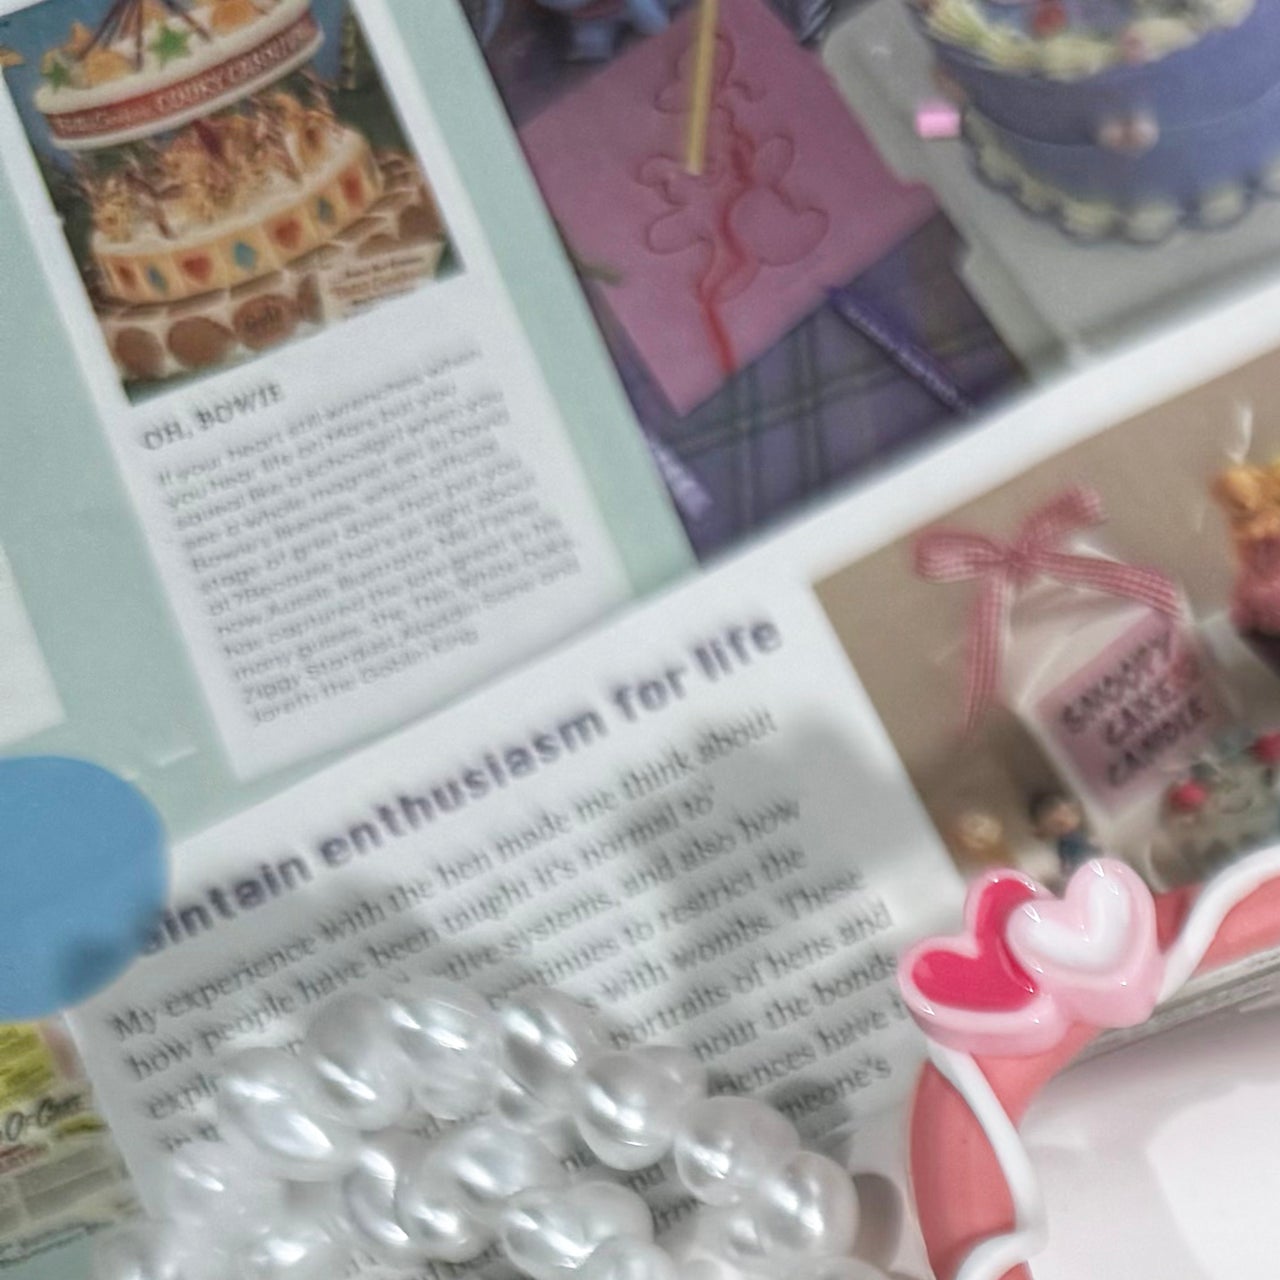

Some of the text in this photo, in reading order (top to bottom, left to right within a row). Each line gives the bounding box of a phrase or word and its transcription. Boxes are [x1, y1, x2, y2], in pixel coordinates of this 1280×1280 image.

[132, 619, 784, 957] aintain enthusiasm for life
